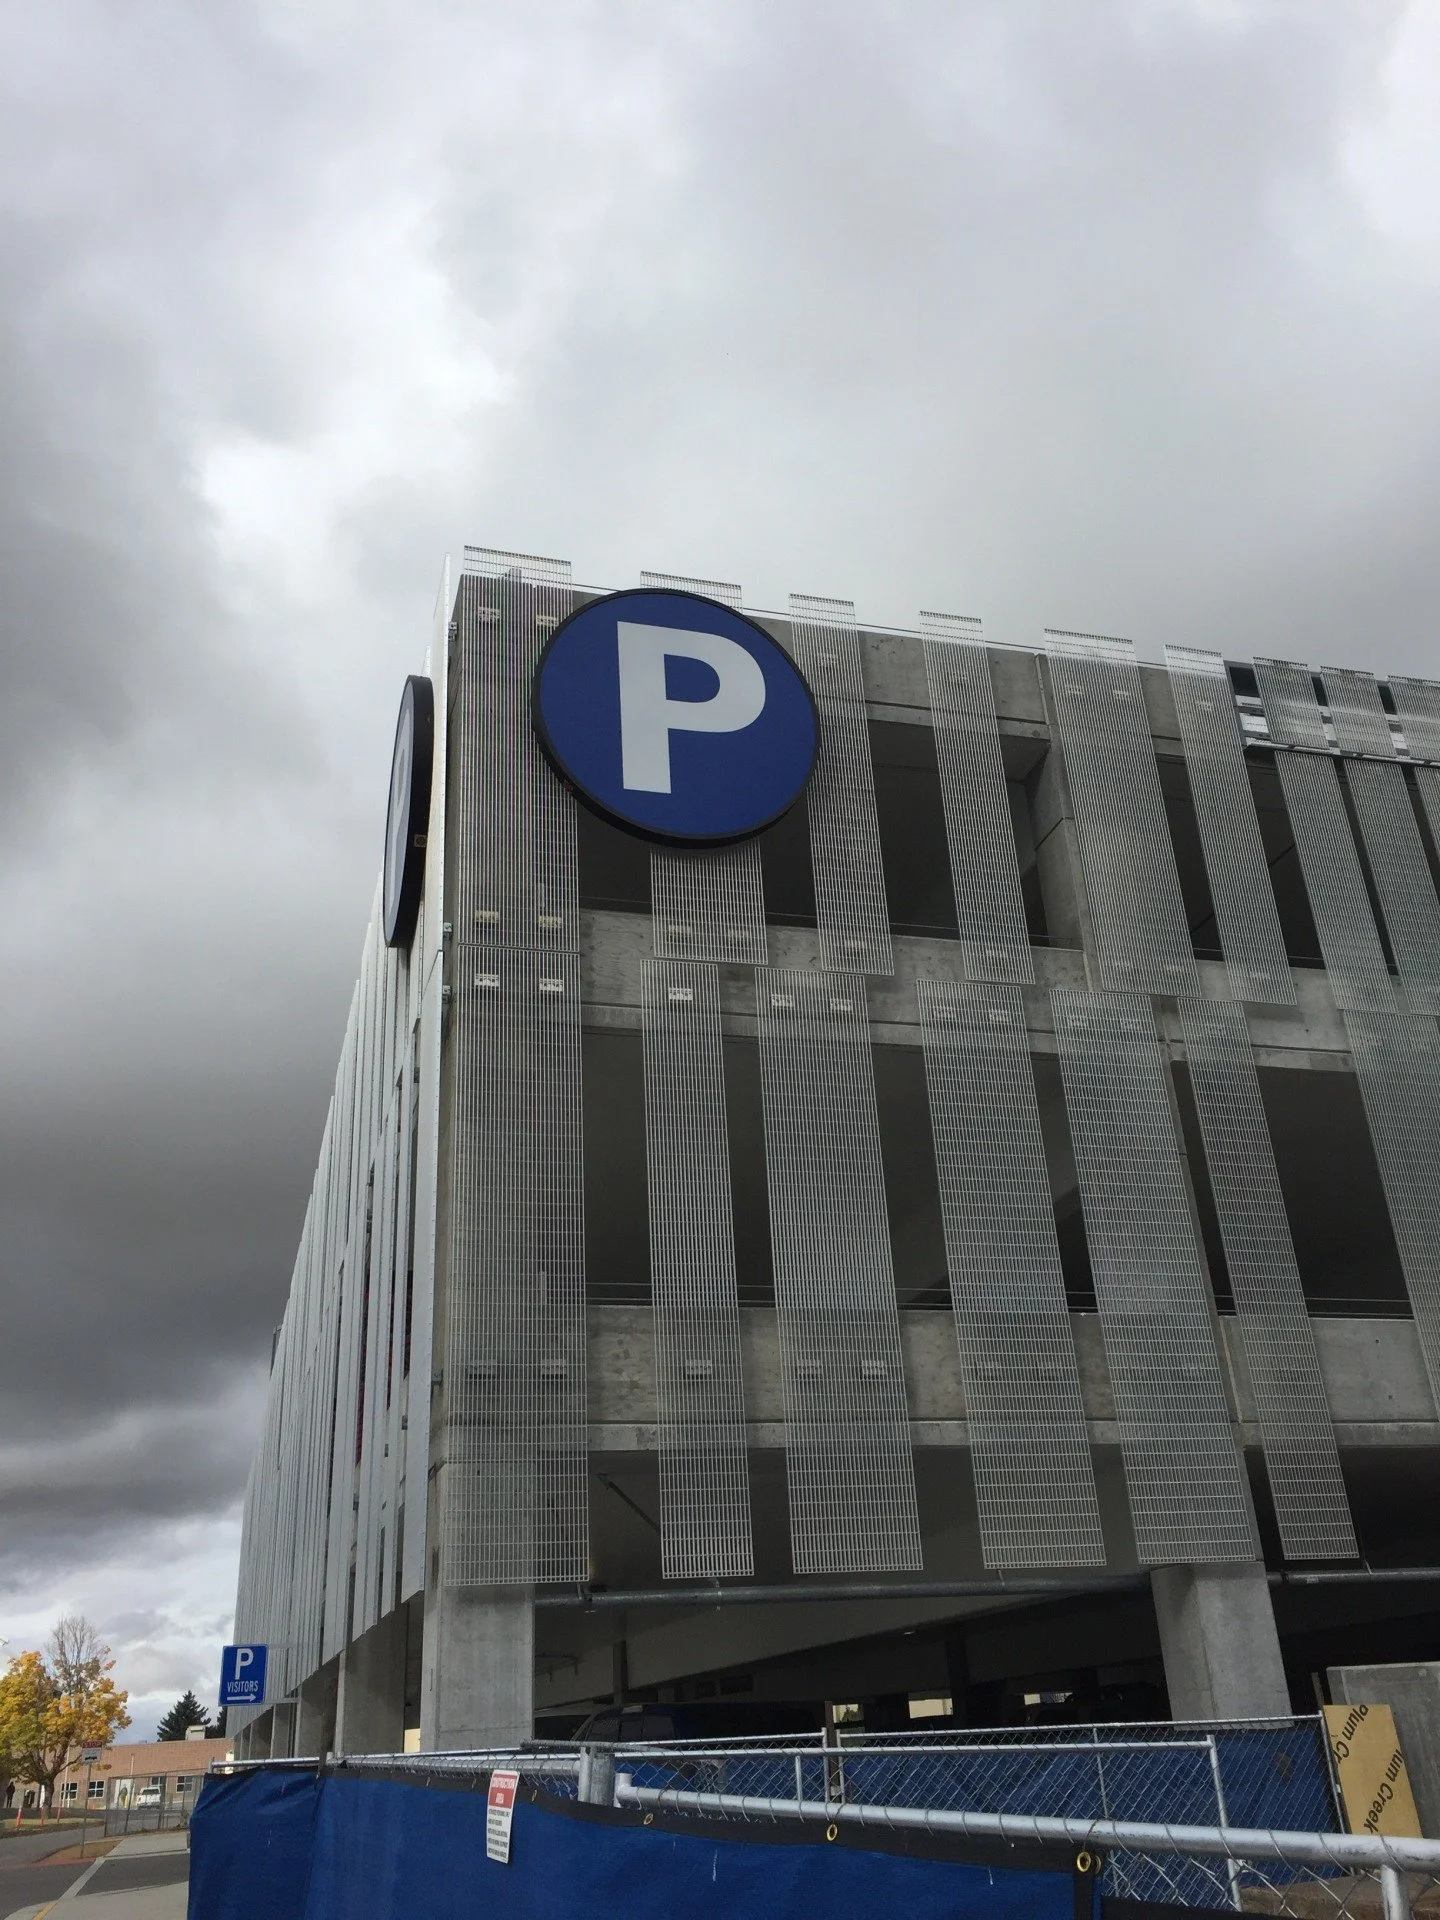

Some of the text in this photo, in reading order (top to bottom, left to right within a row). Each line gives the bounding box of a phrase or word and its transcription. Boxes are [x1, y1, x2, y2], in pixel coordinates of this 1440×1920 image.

[617, 621, 766, 794] P
[388, 708, 411, 916] P
[227, 1680, 259, 1693] VISITORS
[234, 1648, 254, 1680] P
[1363, 1782, 1394, 1834] Creek
